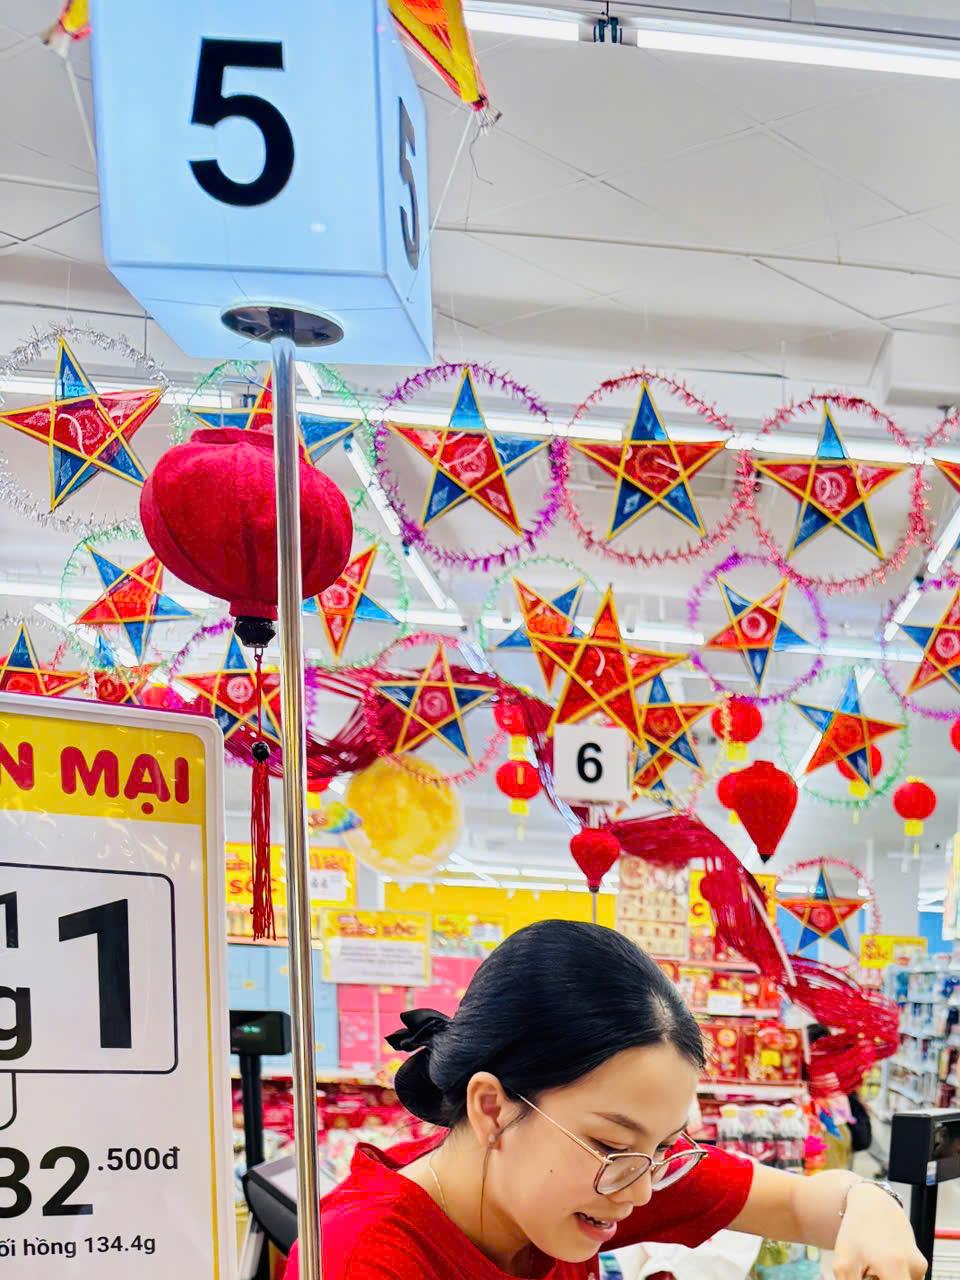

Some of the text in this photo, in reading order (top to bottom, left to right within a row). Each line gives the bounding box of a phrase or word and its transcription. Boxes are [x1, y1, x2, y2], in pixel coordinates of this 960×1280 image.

[188, 36, 295, 207] 5
[398, 97, 421, 271] 5
[60, 745, 190, 815] MẠI
[576, 741, 603, 783] 6
[58, 898, 132, 1049] 1
[23, 1237, 76, 1258] hồng
[84, 1235, 156, 1255] 134.4g
